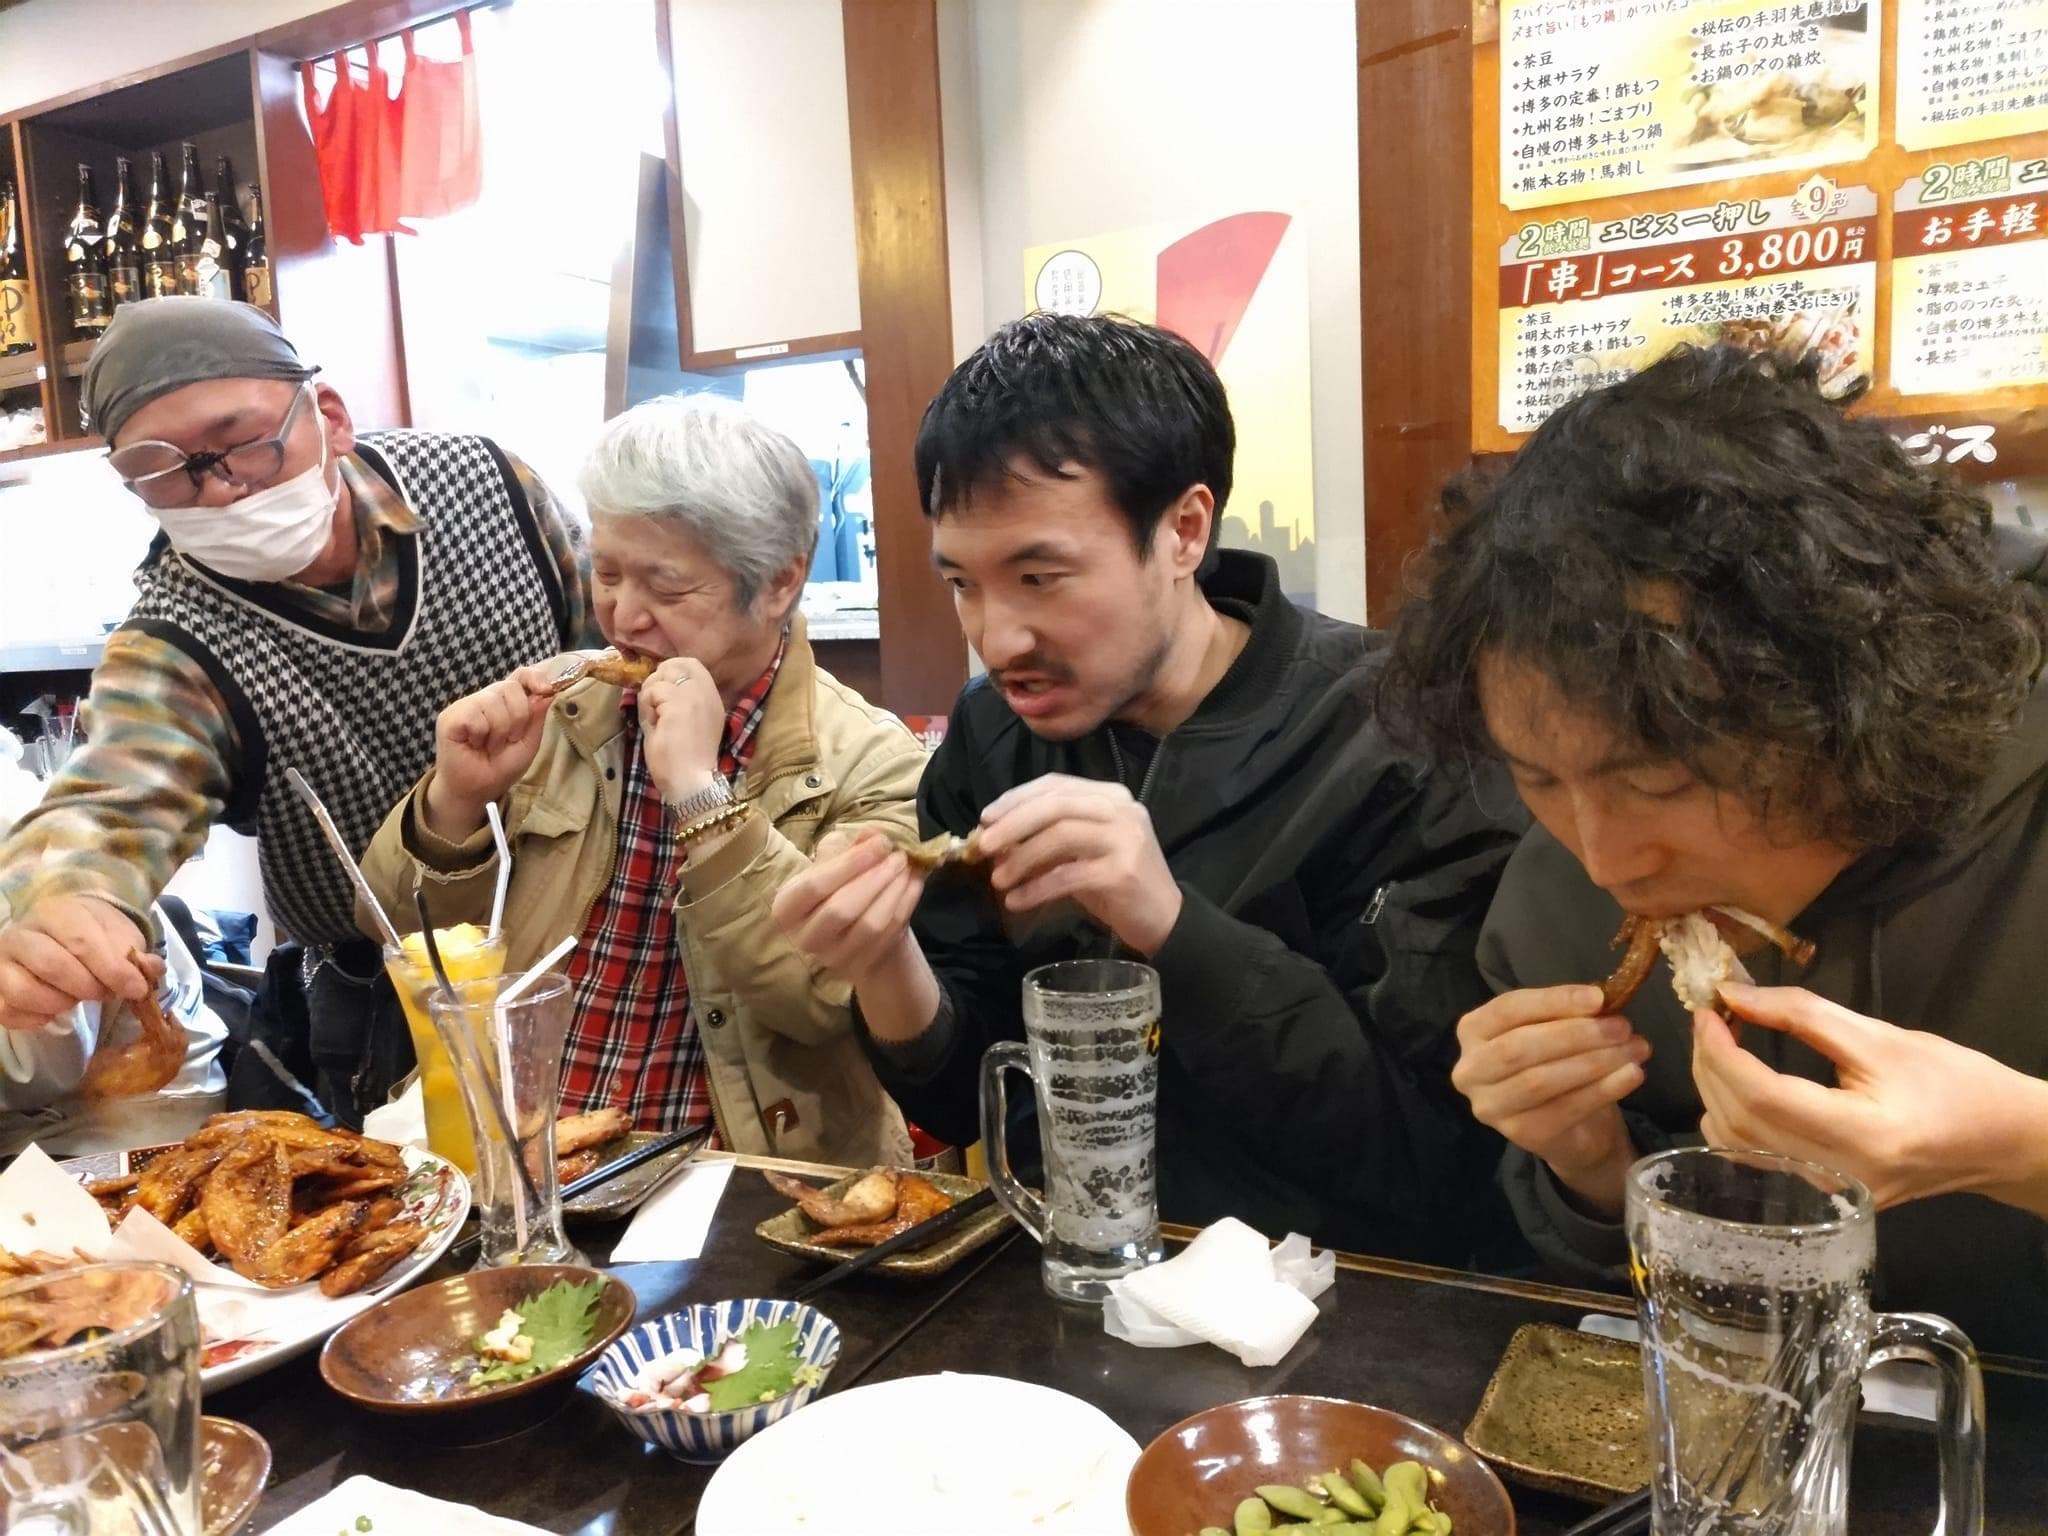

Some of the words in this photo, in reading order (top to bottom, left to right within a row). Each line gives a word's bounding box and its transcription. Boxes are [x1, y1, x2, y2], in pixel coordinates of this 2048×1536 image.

[1523, 51, 1554, 69] 茶豆
[1700, 27, 1820, 61] 長茄子の丸焼き
[1522, 64, 1600, 92] 大根サラダ
[1521, 123, 1663, 159] 自慢の博多牛もつ鍋
[1522, 160, 1646, 192] 熊本名物！馬刺し
[1600, 200, 1770, 243] エビス一押し
[1921, 202, 2041, 246] お手軽
[1526, 312, 1552, 327] 茶豆
